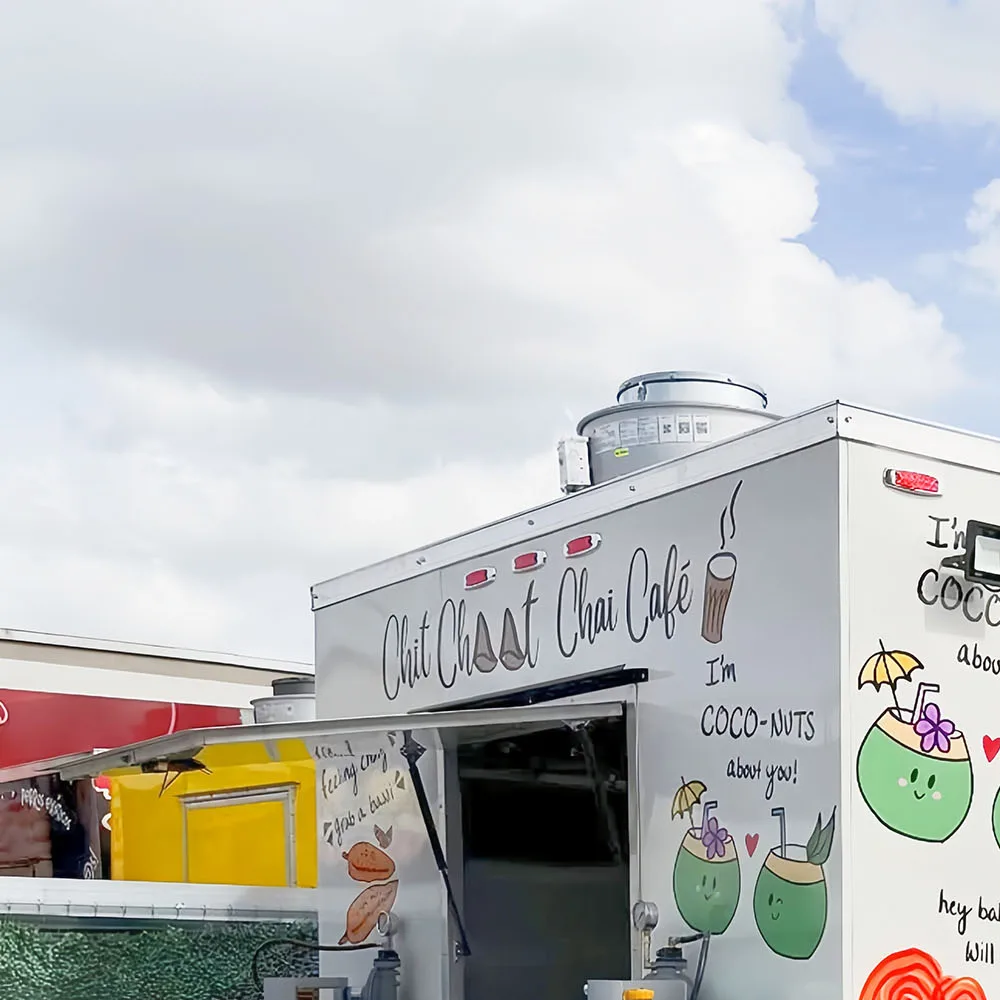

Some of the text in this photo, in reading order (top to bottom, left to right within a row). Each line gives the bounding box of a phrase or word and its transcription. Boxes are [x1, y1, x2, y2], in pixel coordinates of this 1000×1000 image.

[383, 611, 431, 700] Chit
[557, 566, 618, 658] Chai
[626, 544, 693, 643] Café
[705, 654, 737, 686] I'm
[701, 704, 815, 741] COCO-NUTS
[726, 756, 798, 801] about you!
[938, 889, 973, 935] hey
